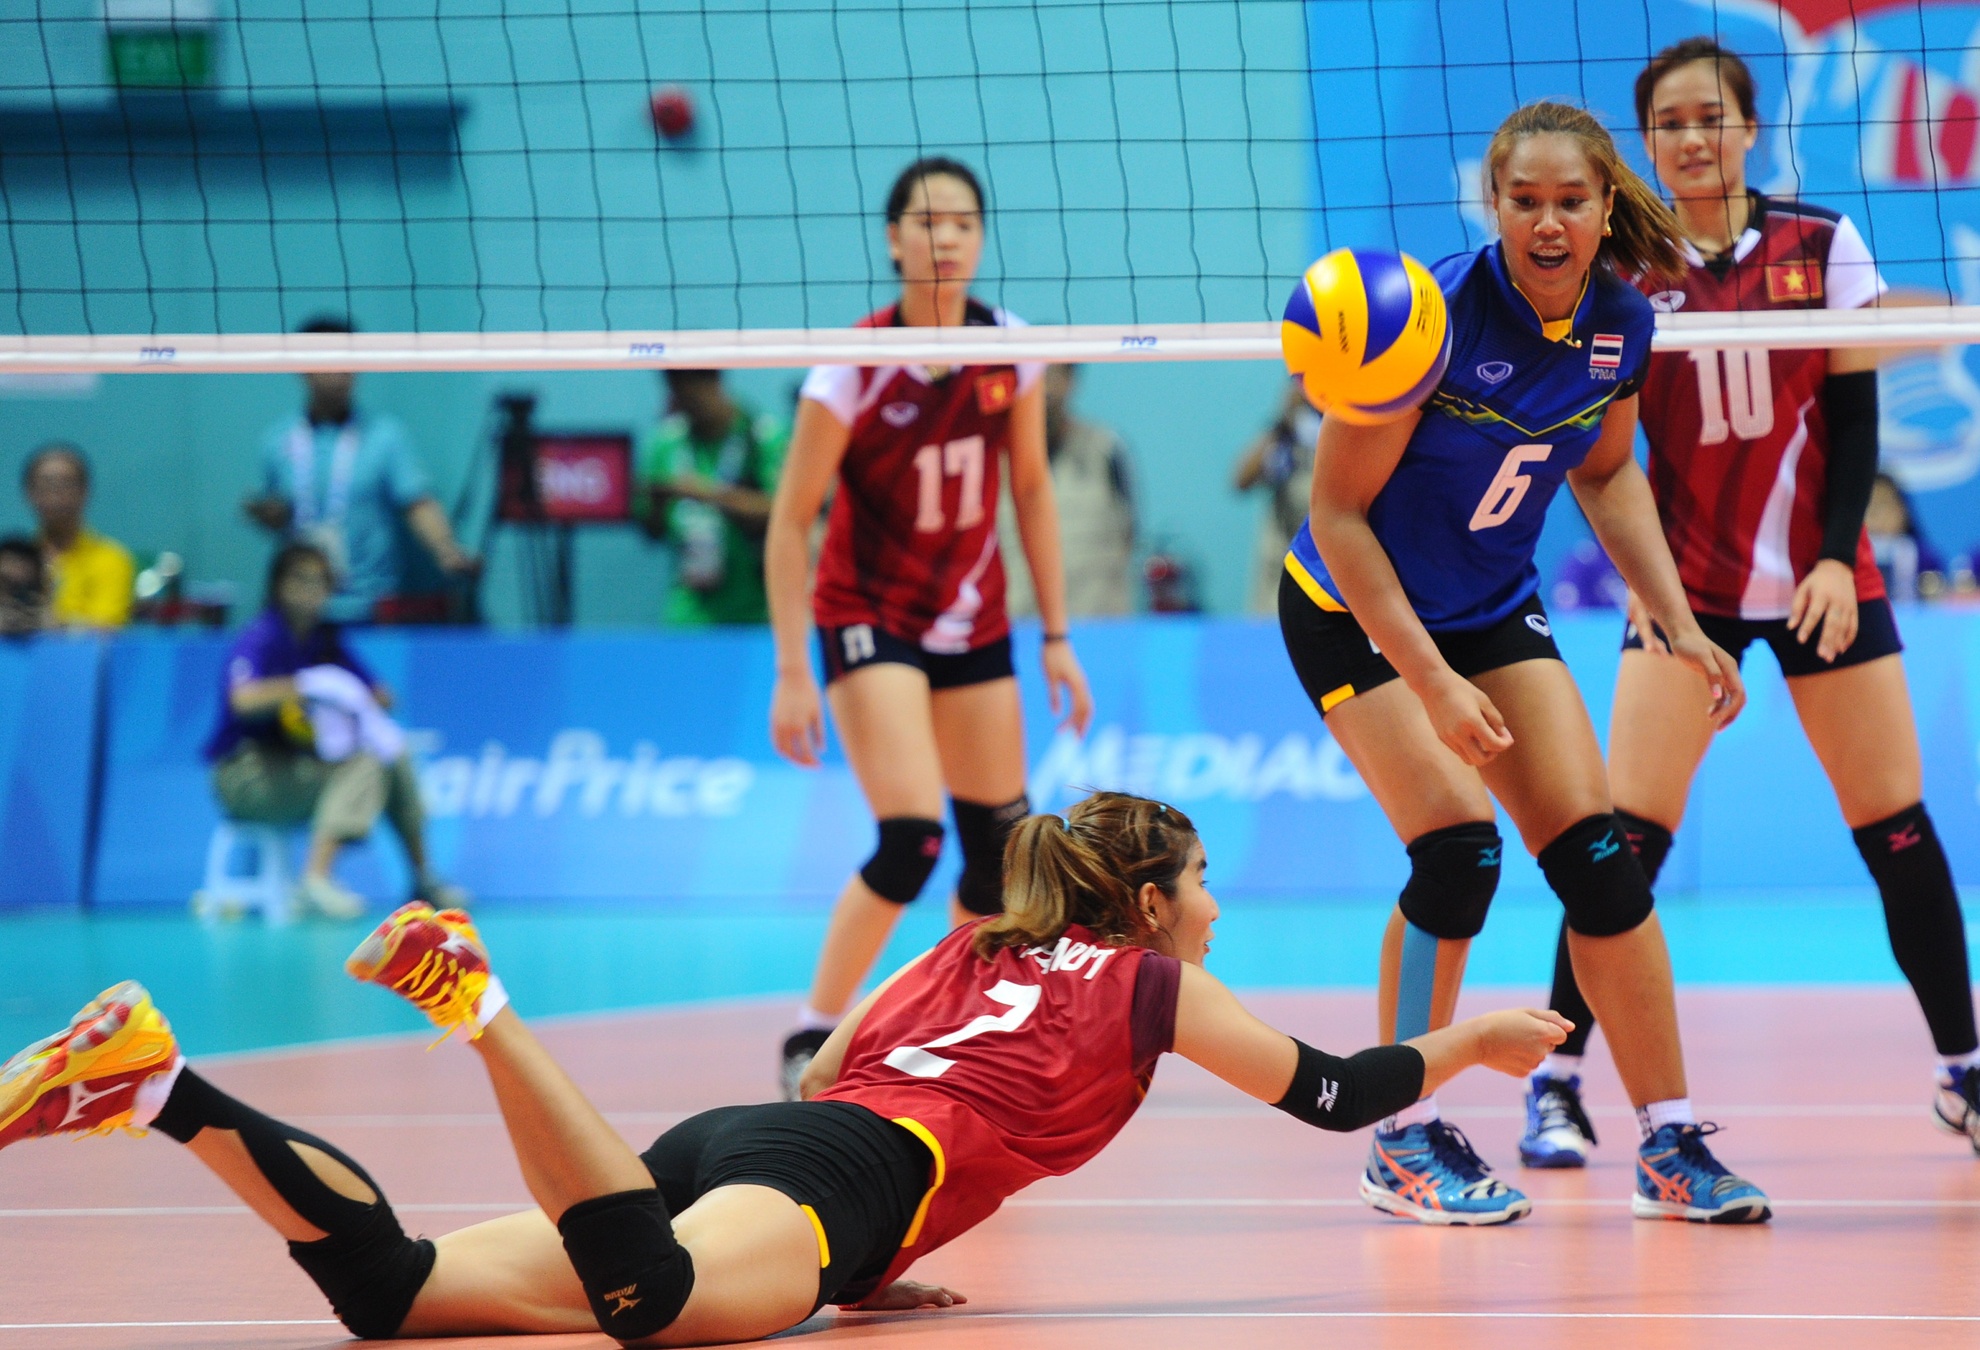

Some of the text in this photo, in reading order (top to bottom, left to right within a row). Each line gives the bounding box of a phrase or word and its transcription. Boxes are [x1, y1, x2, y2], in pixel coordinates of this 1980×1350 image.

[1588, 367, 1617, 380] THA
[1687, 348, 1775, 447] 10
[913, 434, 986, 533] 17
[1468, 443, 1553, 532] 6
[882, 979, 1042, 1078] 2
